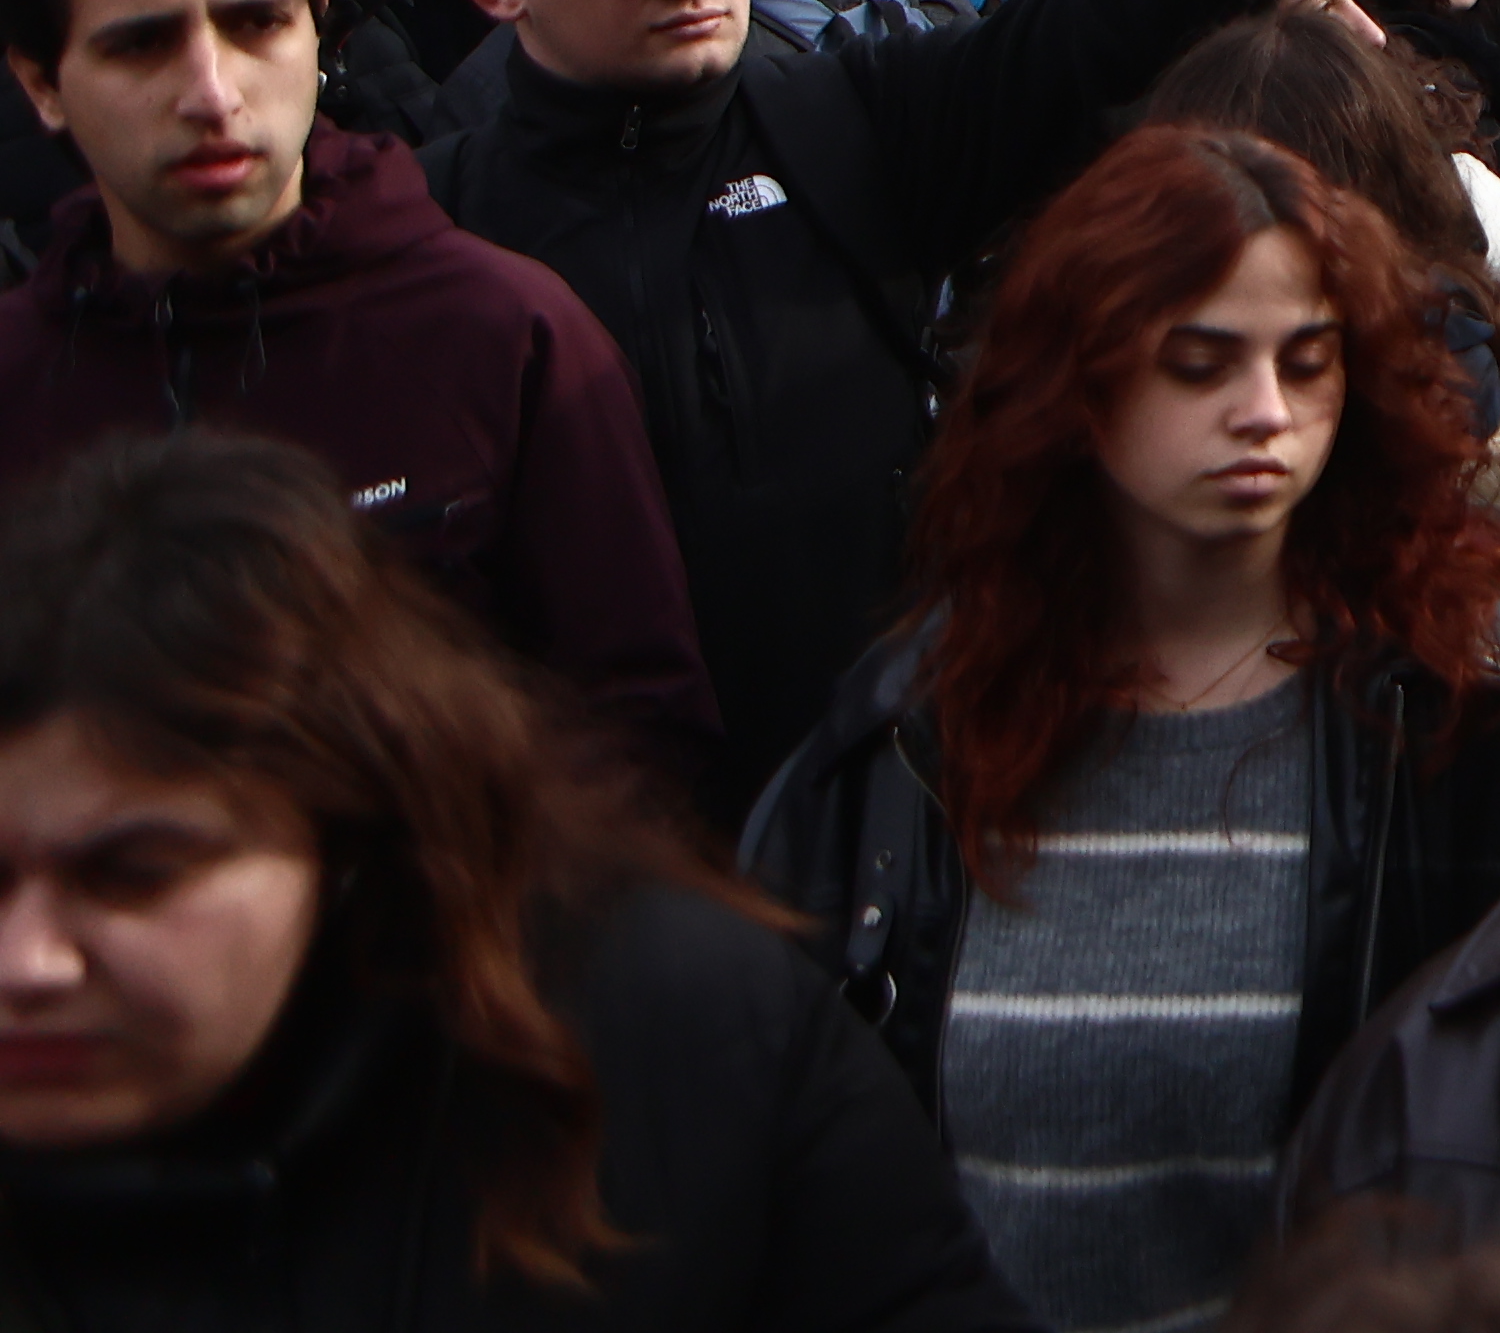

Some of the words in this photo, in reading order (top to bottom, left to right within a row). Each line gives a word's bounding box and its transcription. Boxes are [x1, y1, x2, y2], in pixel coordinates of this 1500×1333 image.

[725, 177, 756, 193] THE
[708, 188, 759, 212] NORTH
[726, 200, 763, 217] FACE
